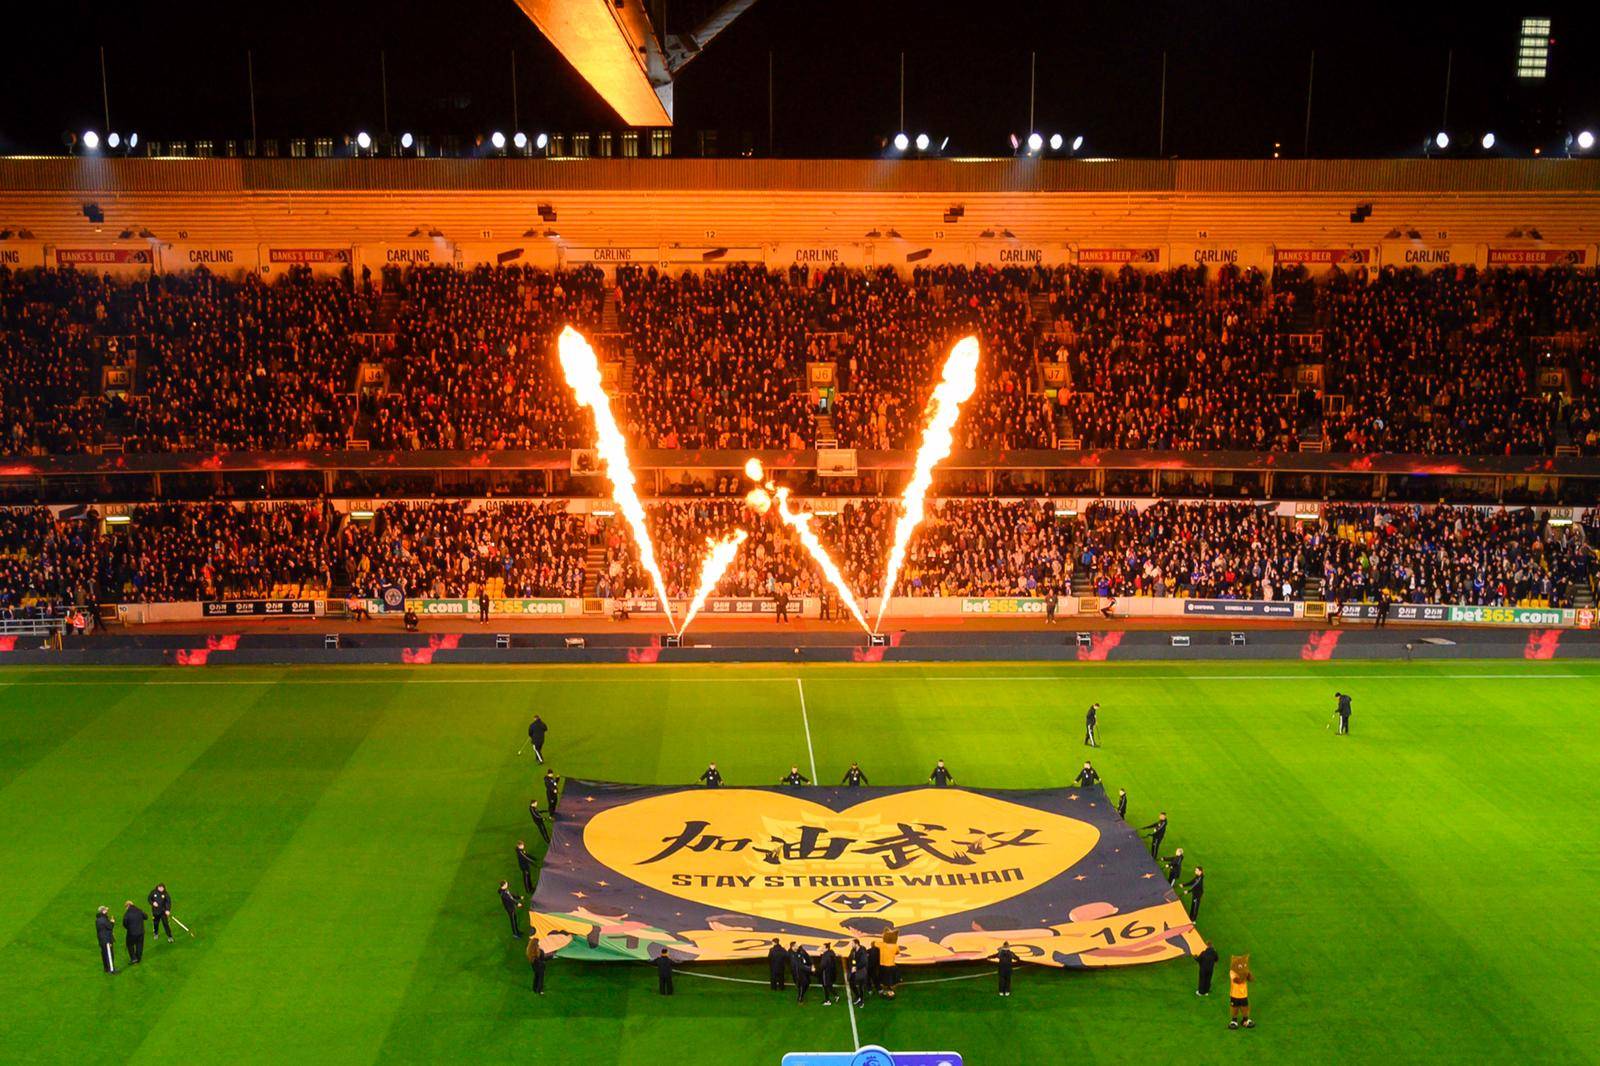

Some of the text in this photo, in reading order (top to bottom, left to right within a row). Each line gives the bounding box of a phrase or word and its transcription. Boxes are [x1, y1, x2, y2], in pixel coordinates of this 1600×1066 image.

[178, 231, 188, 239] 10
[1199, 231, 1207, 239] 14
[95, 251, 115, 261] BEER
[189, 250, 233, 262] CARLING
[305, 251, 324, 261] BEER
[387, 250, 430, 262] CARLING
[594, 250, 631, 260] CARLING
[796, 250, 838, 262] CARLING
[1000, 250, 1042, 262] CARLING
[1112, 251, 1131, 261] BEER
[1195, 250, 1238, 262] CARLING
[1311, 251, 1331, 261] BEER
[1405, 250, 1450, 262] CARLING
[1525, 252, 1546, 262] BEER
[112, 373, 126, 383] J3
[368, 371, 381, 381] J4
[815, 370, 828, 380] J6
[1048, 370, 1060, 380] J7
[1452, 608, 1559, 624] bet365.com
[634, 821, 1049, 869] 加油武汉
[672, 867, 1024, 887] STAY STRONG WUHAN
[1091, 920, 1154, 945] 16
